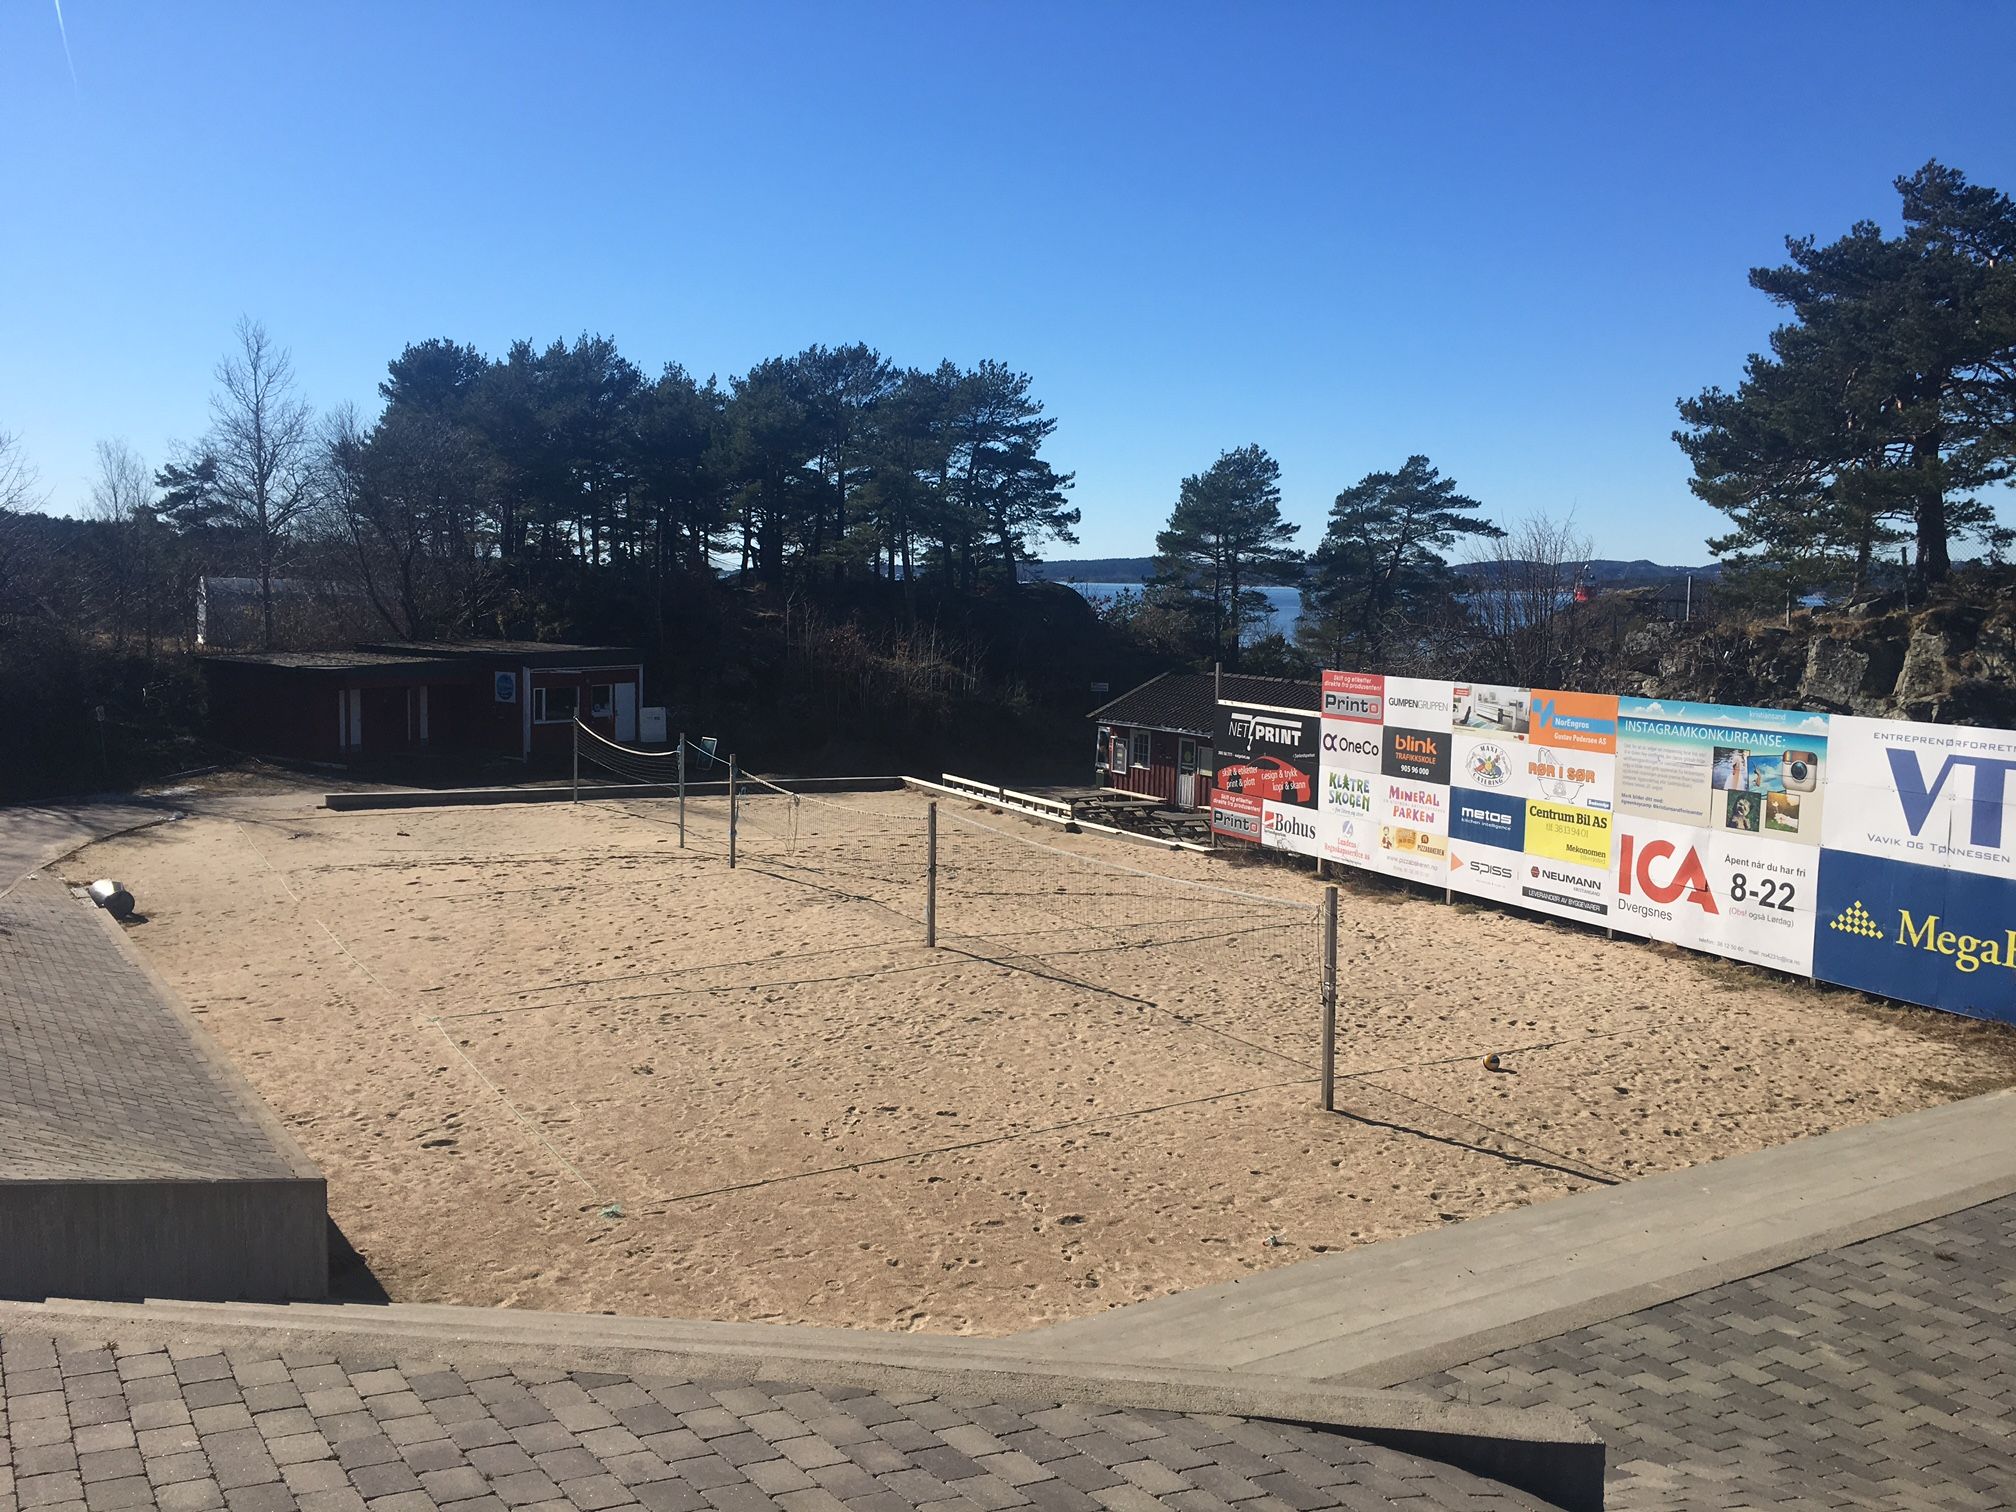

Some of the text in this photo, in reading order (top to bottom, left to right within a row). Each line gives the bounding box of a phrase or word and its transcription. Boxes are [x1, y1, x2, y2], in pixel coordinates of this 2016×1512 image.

[1554, 718, 1590, 729] NorEngros
[1228, 721, 1302, 746] NET PRINT
[1554, 732, 1607, 745] Gustav Pedersen AS
[1625, 719, 1786, 748] INSTAGRAMKONKURRANSE:
[1873, 731, 2016, 753] ENTREPRENØRFORRET
[1339, 737, 1379, 756] OneCo
[1395, 734, 1437, 754] blink
[1480, 745, 1498, 754] MAXI
[1395, 752, 1437, 765] TRAFIKKSKOLE
[1222, 767, 1232, 776] skilt
[1261, 771, 1278, 781] design
[1284, 768, 1298, 780] trykk
[1400, 764, 1430, 776] 905 96 000
[1472, 772, 1503, 785] CATERING
[1528, 762, 1596, 783] RØR I SØR
[1226, 779, 1239, 790] print
[1290, 781, 1306, 790] skann
[1328, 790, 1371, 812] SKOGEN
[1885, 747, 2016, 849] VT
[1393, 805, 1435, 823] PARKEN
[1461, 806, 1512, 825] metos
[1461, 817, 1481, 826] kitchen
[1529, 805, 1608, 829] Centrum Bil AS
[1275, 812, 1316, 840] Bohus
[1566, 843, 1606, 859] Mekonomen
[1867, 832, 2011, 864] VAVIK OG TØNNESSEN
[1618, 833, 1720, 915] ICA
[1751, 858, 1765, 870] når
[1766, 862, 1778, 873] du
[1780, 864, 1794, 876] har
[1796, 867, 1806, 878] fri
[1542, 870, 1602, 890] NEUMANN
[1730, 872, 1796, 912] 8-22
[1560, 897, 1568, 905] AV
[1568, 898, 1601, 912] BYGGEVARER
[1618, 898, 1673, 921] Dvergsnes
[1748, 911, 1766, 922] også
[1767, 914, 1795, 928] Lørdag)
